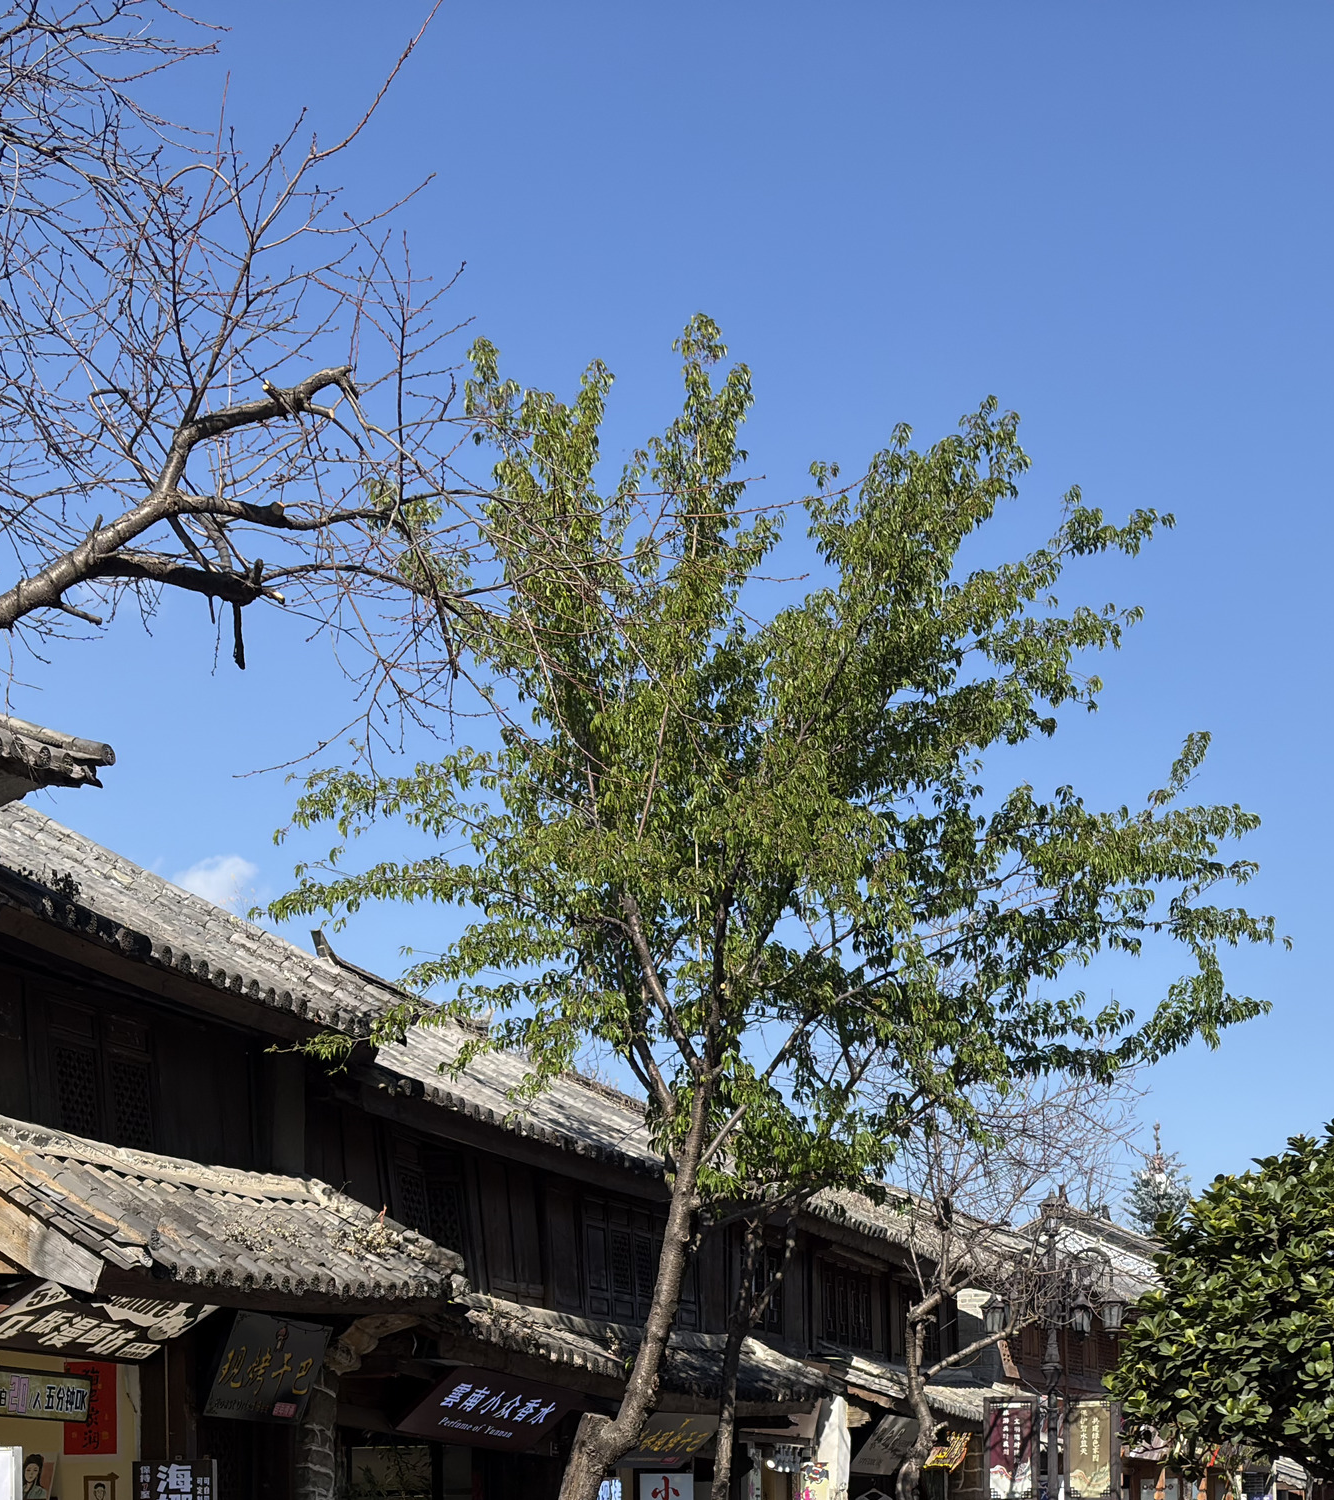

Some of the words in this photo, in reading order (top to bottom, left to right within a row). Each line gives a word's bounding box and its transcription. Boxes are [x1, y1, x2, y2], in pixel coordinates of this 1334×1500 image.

[440, 1383, 555, 1425] 雲南小众香水
[438, 1417, 472, 1431] Perfume
